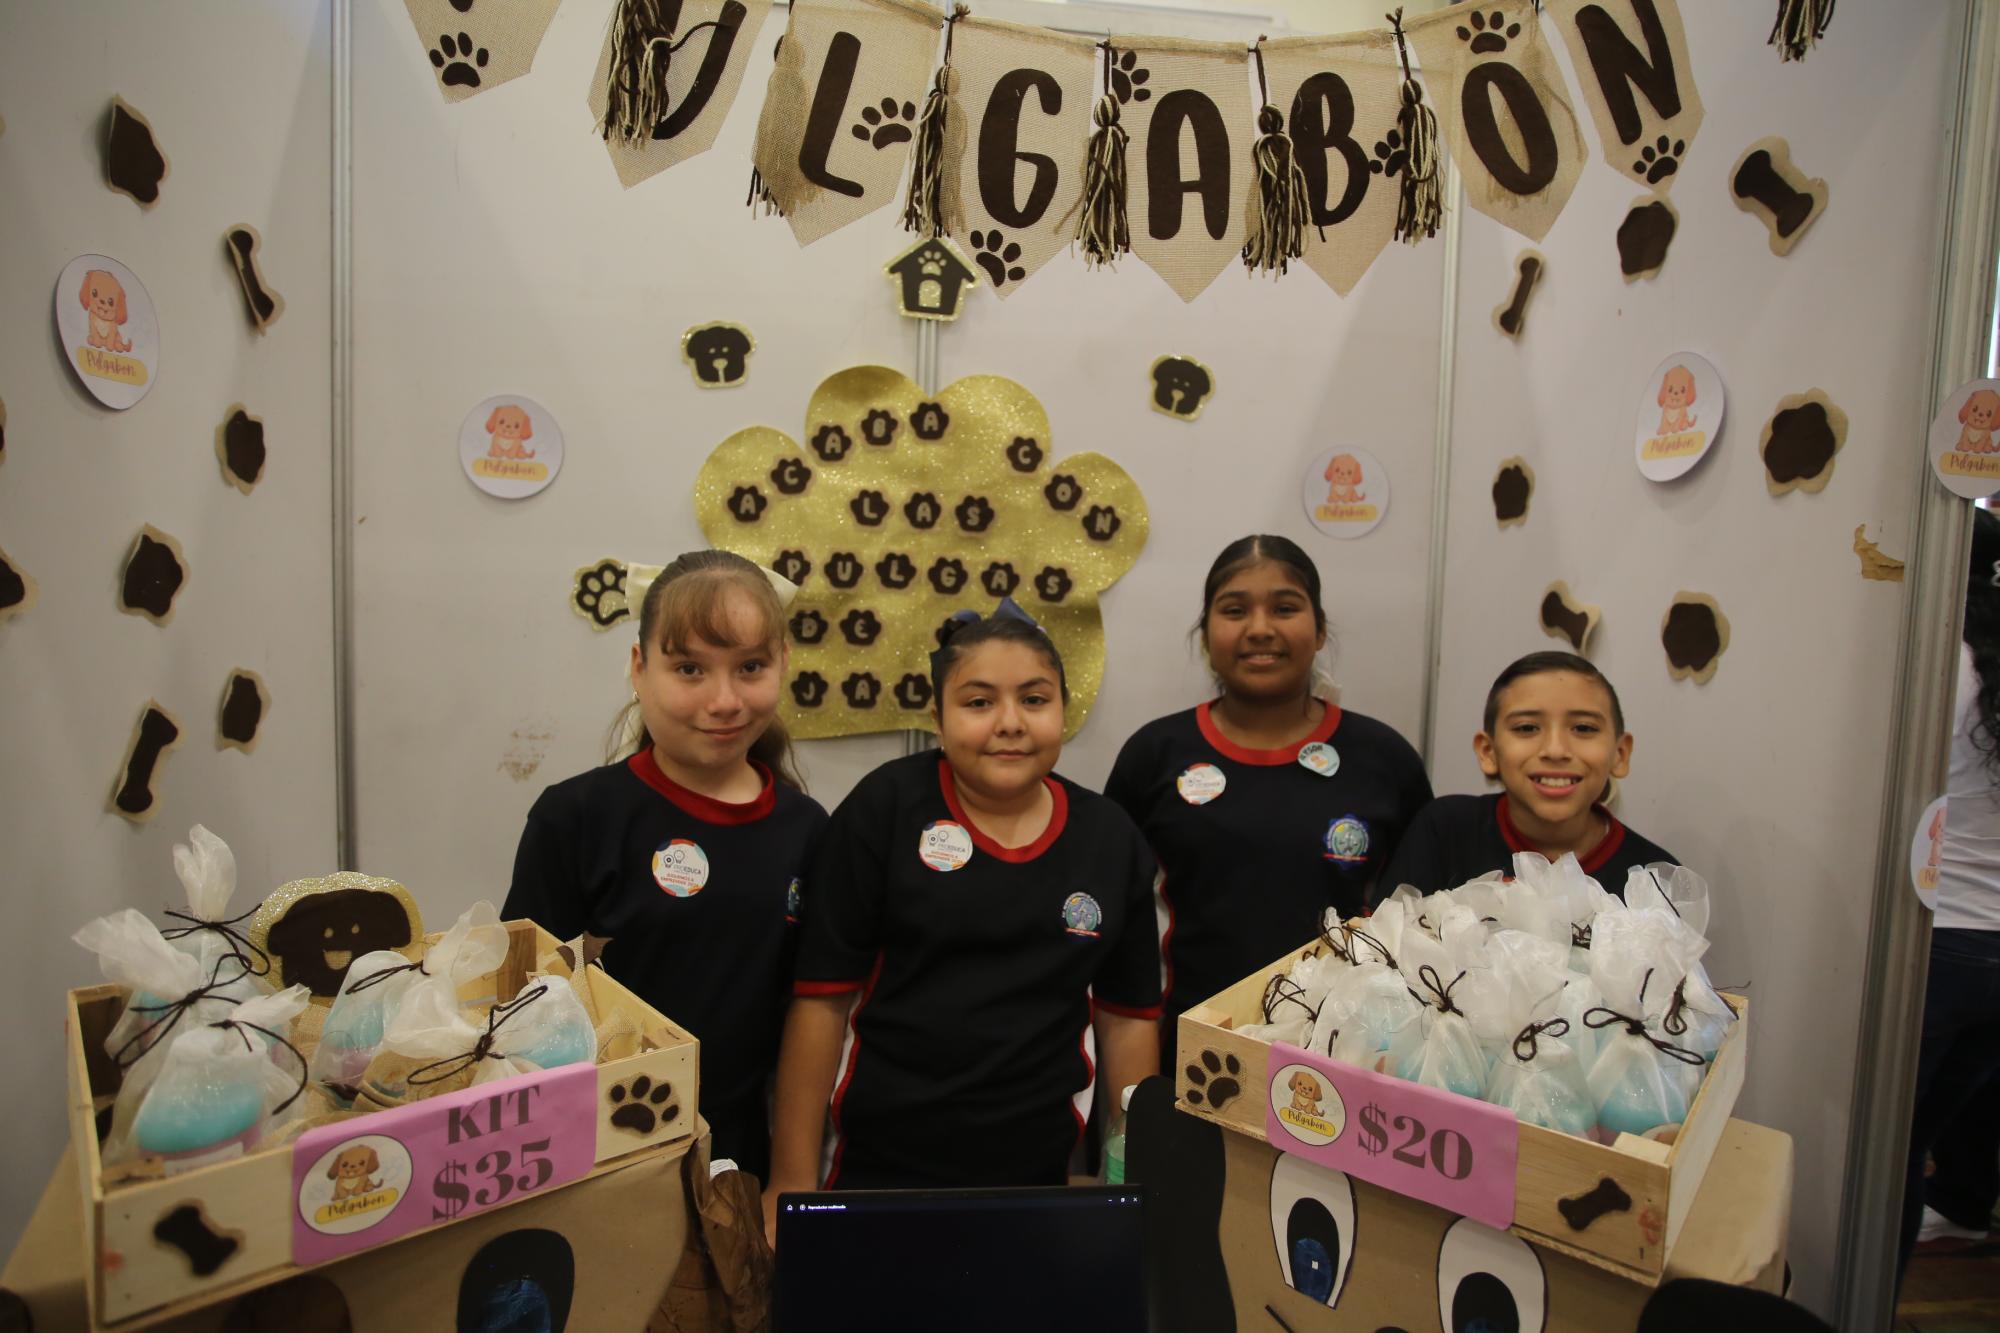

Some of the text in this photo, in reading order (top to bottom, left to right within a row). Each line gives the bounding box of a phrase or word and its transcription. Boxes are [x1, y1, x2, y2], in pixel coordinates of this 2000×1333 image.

[448, 0, 1682, 241] ULGABON
[86, 349, 137, 377] Pulgabon
[738, 410, 1113, 534] ACABA CON
[862, 496, 982, 527] LAS
[786, 558, 1061, 590] PULGAS
[801, 616, 869, 639] DE
[802, 680, 923, 702] JAL
[448, 1085, 540, 1145] KIT
[1287, 1101, 1473, 1181] Pulgabon $20
[432, 1137, 554, 1221] $35
